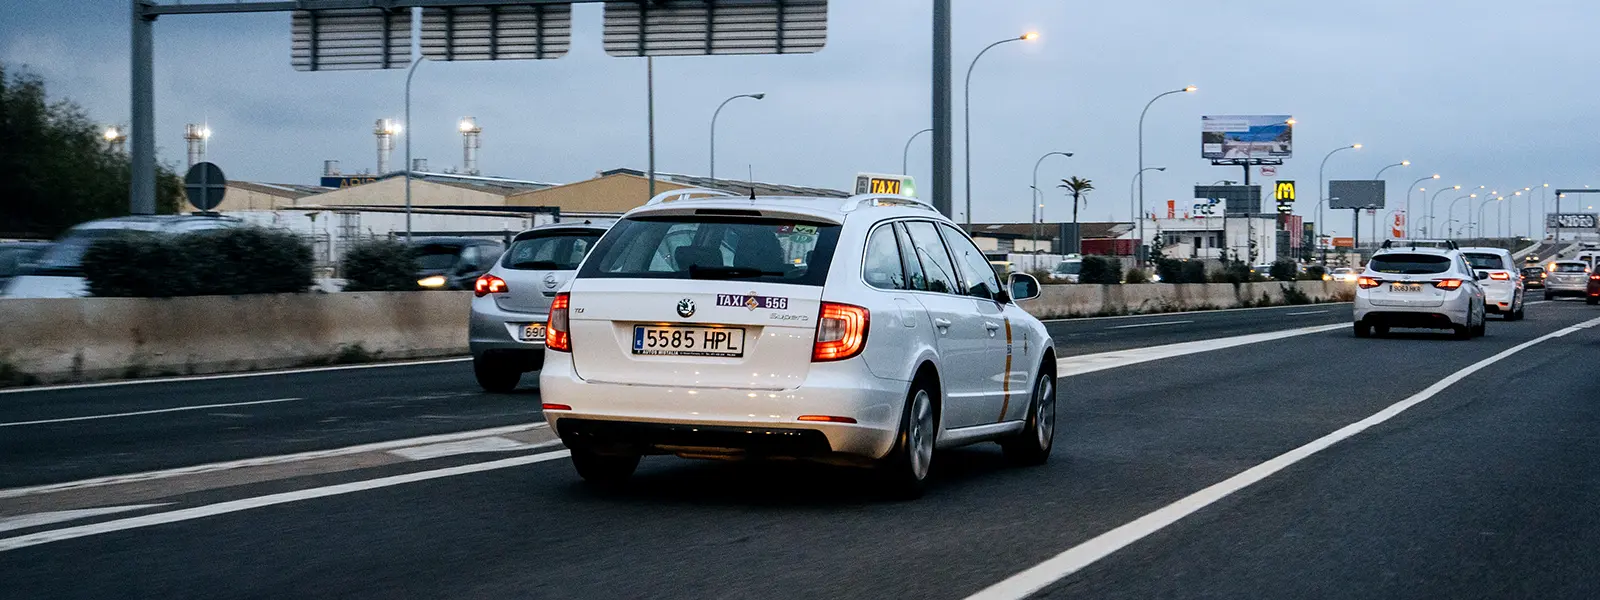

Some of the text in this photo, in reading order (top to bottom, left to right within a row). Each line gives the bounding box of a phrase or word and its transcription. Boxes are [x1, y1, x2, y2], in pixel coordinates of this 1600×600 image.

[871, 179, 899, 194] TAXI
[1193, 203, 1216, 215] FCC
[718, 294, 787, 309] TAXI 556
[646, 329, 738, 350] 5585 HPL
